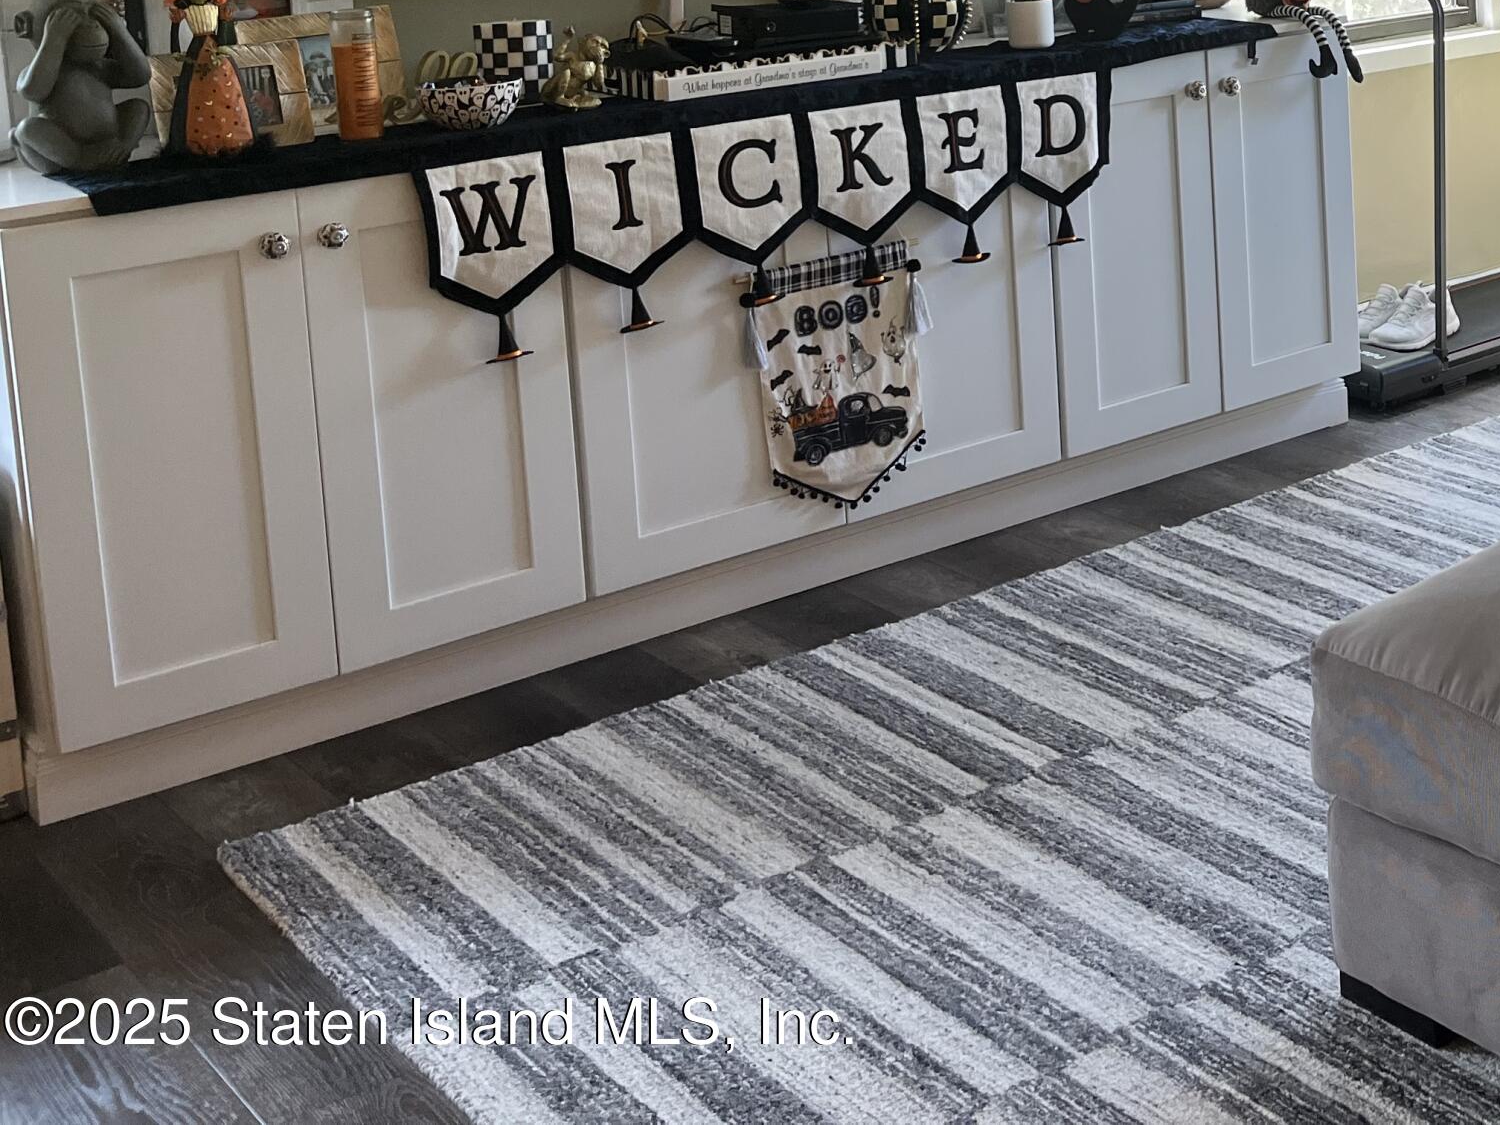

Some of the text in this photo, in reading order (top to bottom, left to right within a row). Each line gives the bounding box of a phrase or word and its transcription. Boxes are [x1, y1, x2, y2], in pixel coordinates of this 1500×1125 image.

[682, 58, 870, 95] What happens at Grandma's stays at Grandma's
[440, 94, 1087, 257] WICKED
[794, 285, 882, 337] BOO!
